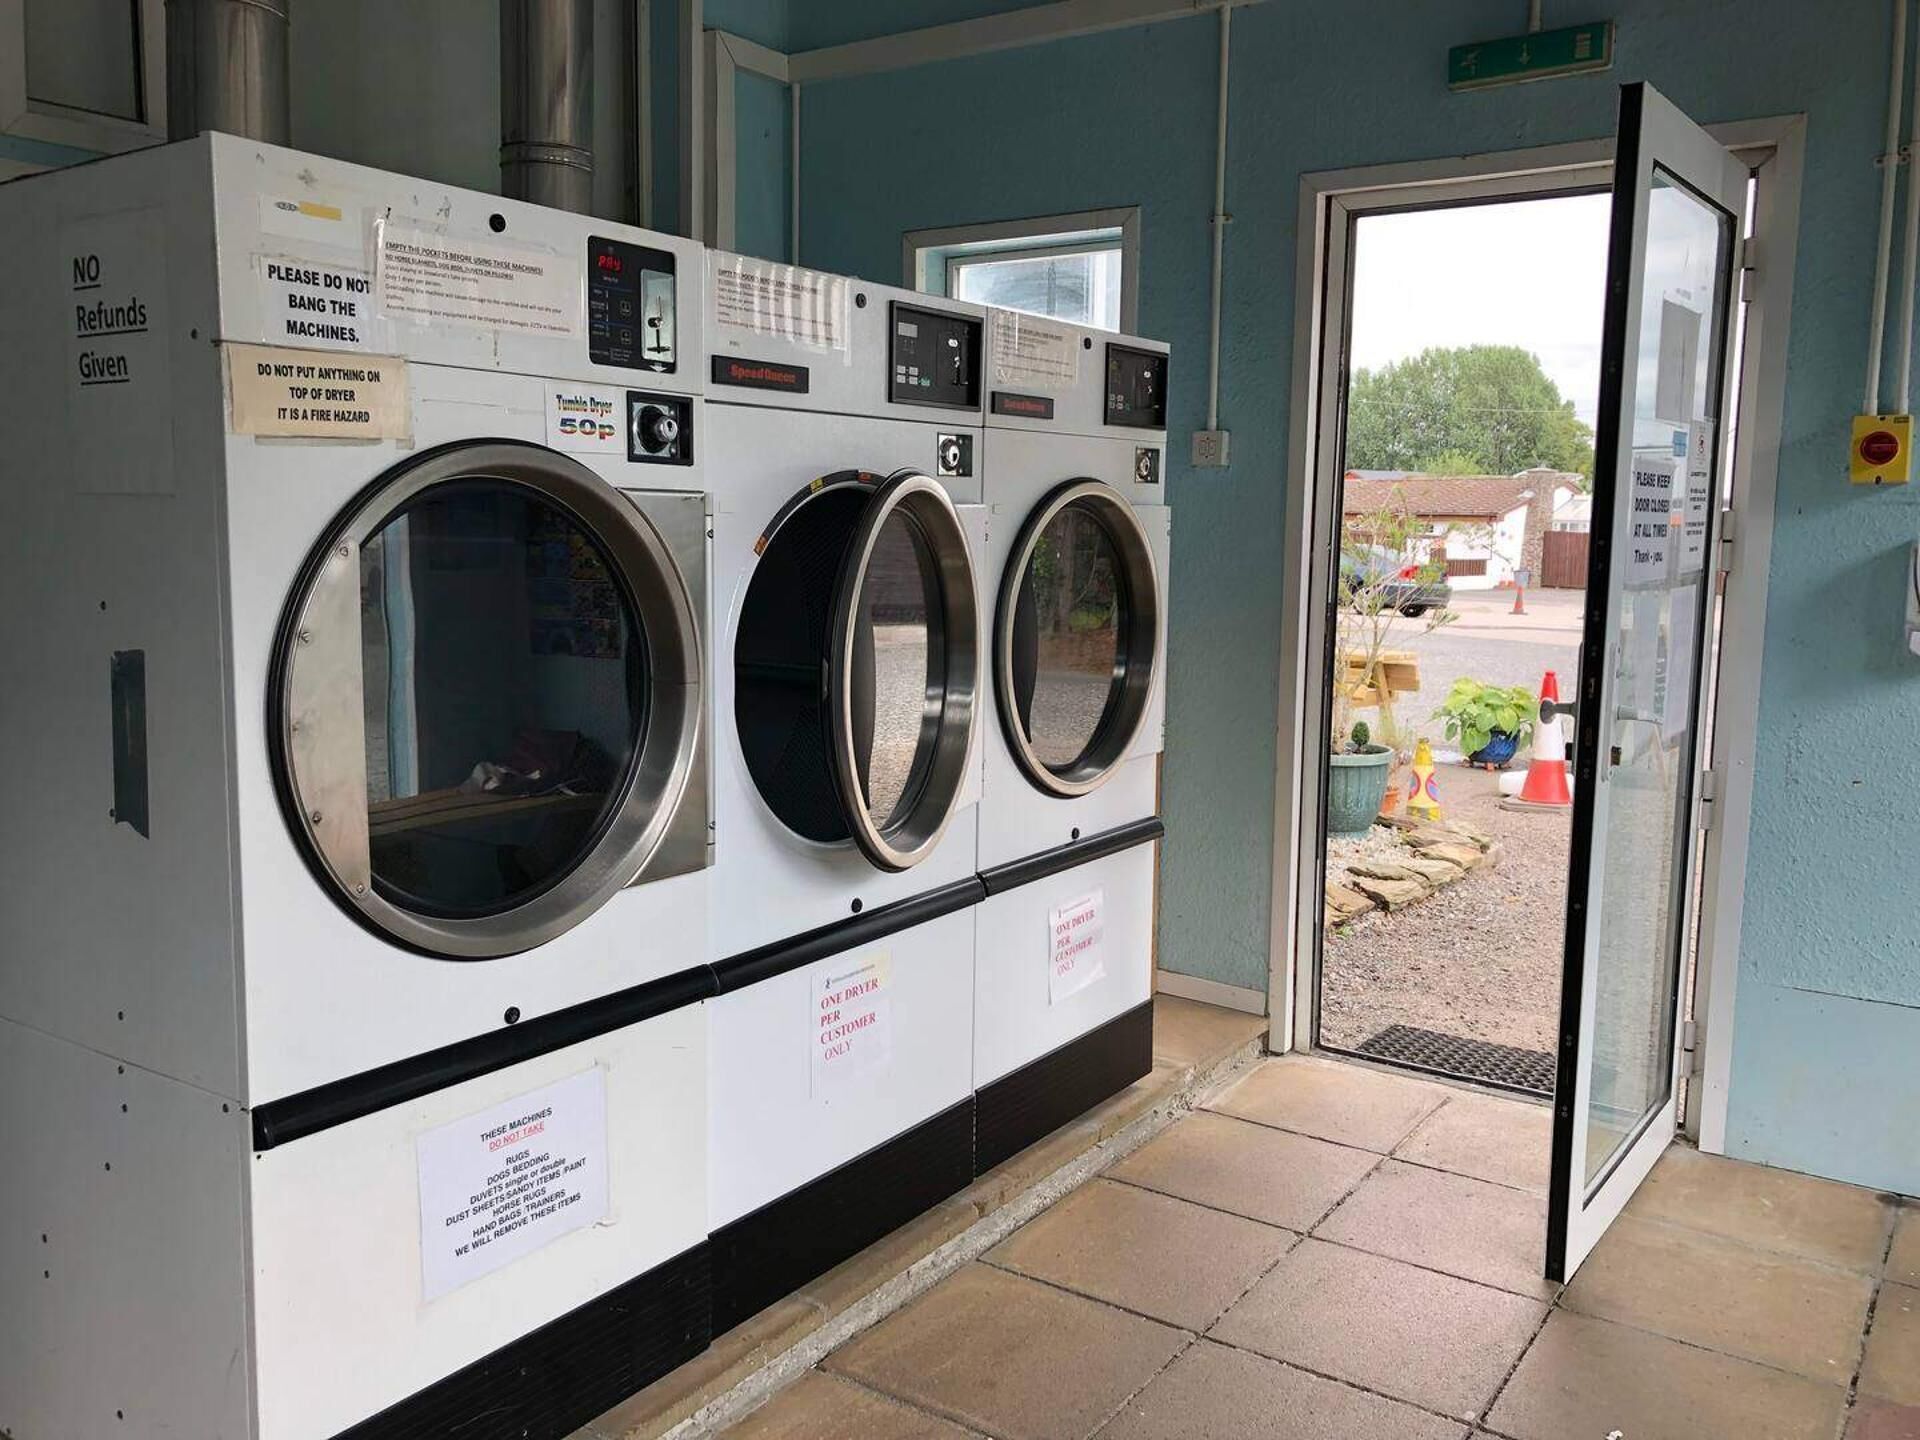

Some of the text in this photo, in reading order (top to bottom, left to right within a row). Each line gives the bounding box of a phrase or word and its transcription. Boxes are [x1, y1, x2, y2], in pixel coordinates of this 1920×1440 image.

[73, 254, 101, 287] NO
[386, 242, 406, 254] EMPTY
[422, 248, 448, 260] POCKETS
[450, 252, 473, 264] BEFORE
[474, 256, 492, 267] USING
[494, 260, 510, 271] THESE
[268, 264, 370, 294] PLEASE DO NOT
[76, 296, 148, 335] Refunds
[288, 294, 356, 317] BANG THE
[286, 319, 360, 343] MACHINES.
[79, 352, 130, 382] Given
[258, 362, 380, 382] DO NOT PUT ANYTHING ON
[289, 386, 356, 402] TOP OF DRYER
[556, 394, 612, 418] Tumble Dryer
[278, 408, 370, 422] IT IS A FIRE HAZARD
[559, 418, 616, 440] 50p
[1636, 472, 1671, 488] PLEASE KEEP
[1635, 498, 1650, 512] DOOR
[1634, 524, 1668, 538] AT ALL TIMES
[820, 978, 880, 1010] ONE DRYER
[820, 1010, 841, 1028] PER
[820, 1012, 876, 1045] CUSTOMER
[824, 1038, 852, 1061] ONLY
[480, 1107, 553, 1142] THESE MACHINES
[488, 1122, 545, 1152] DO NOT TAKE
[487, 1152, 550, 1186] DOGS BEDDING
[506, 1150, 530, 1166] RUGS
[470, 1158, 566, 1205] DUVETS single or double
[446, 1211, 470, 1227] DUST
[472, 1196, 506, 1216] SHEETS
[506, 1180, 535, 1201] SANDY
[536, 1169, 562, 1188] ITEMS
[492, 1186, 547, 1217] HORSE RUGS
[454, 1192, 582, 1258] WE WILL REMOVE THESE ITEMS
[472, 1220, 497, 1238] HAND
[498, 1208, 522, 1226] BAGS
